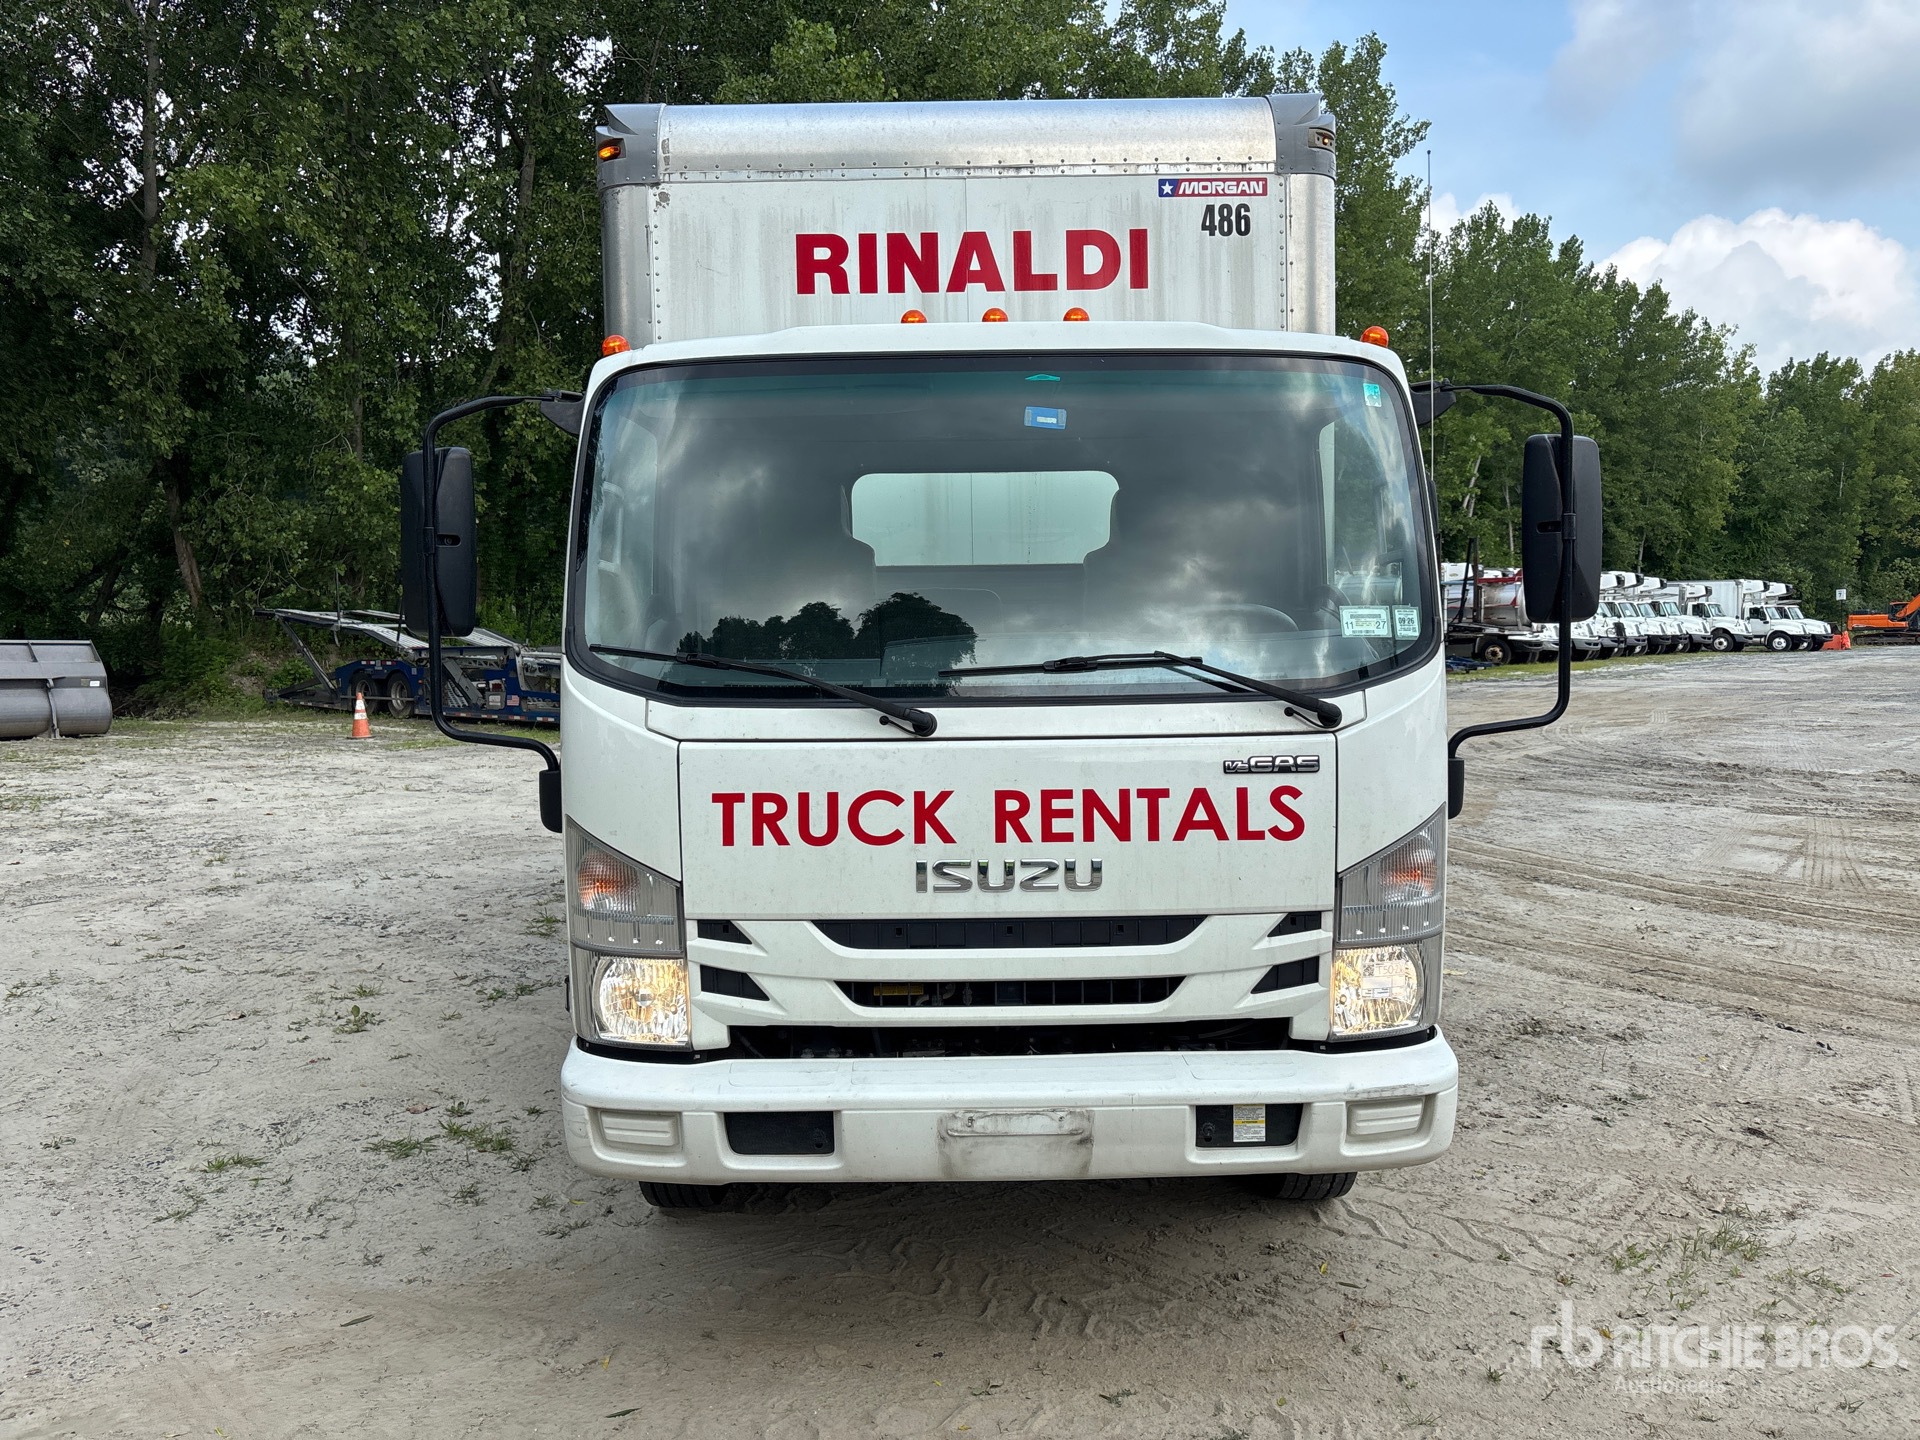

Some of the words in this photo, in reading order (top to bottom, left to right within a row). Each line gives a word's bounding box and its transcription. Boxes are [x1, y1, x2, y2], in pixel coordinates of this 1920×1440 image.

[1178, 181, 1263, 194] MORGAN
[1201, 203, 1251, 236] 486
[795, 228, 1149, 295] RINALDI
[1375, 620, 1387, 629] 27
[711, 789, 958, 847] TRUCK
[994, 785, 1305, 844] RENTALS
[915, 858, 1103, 893] ISUZU
